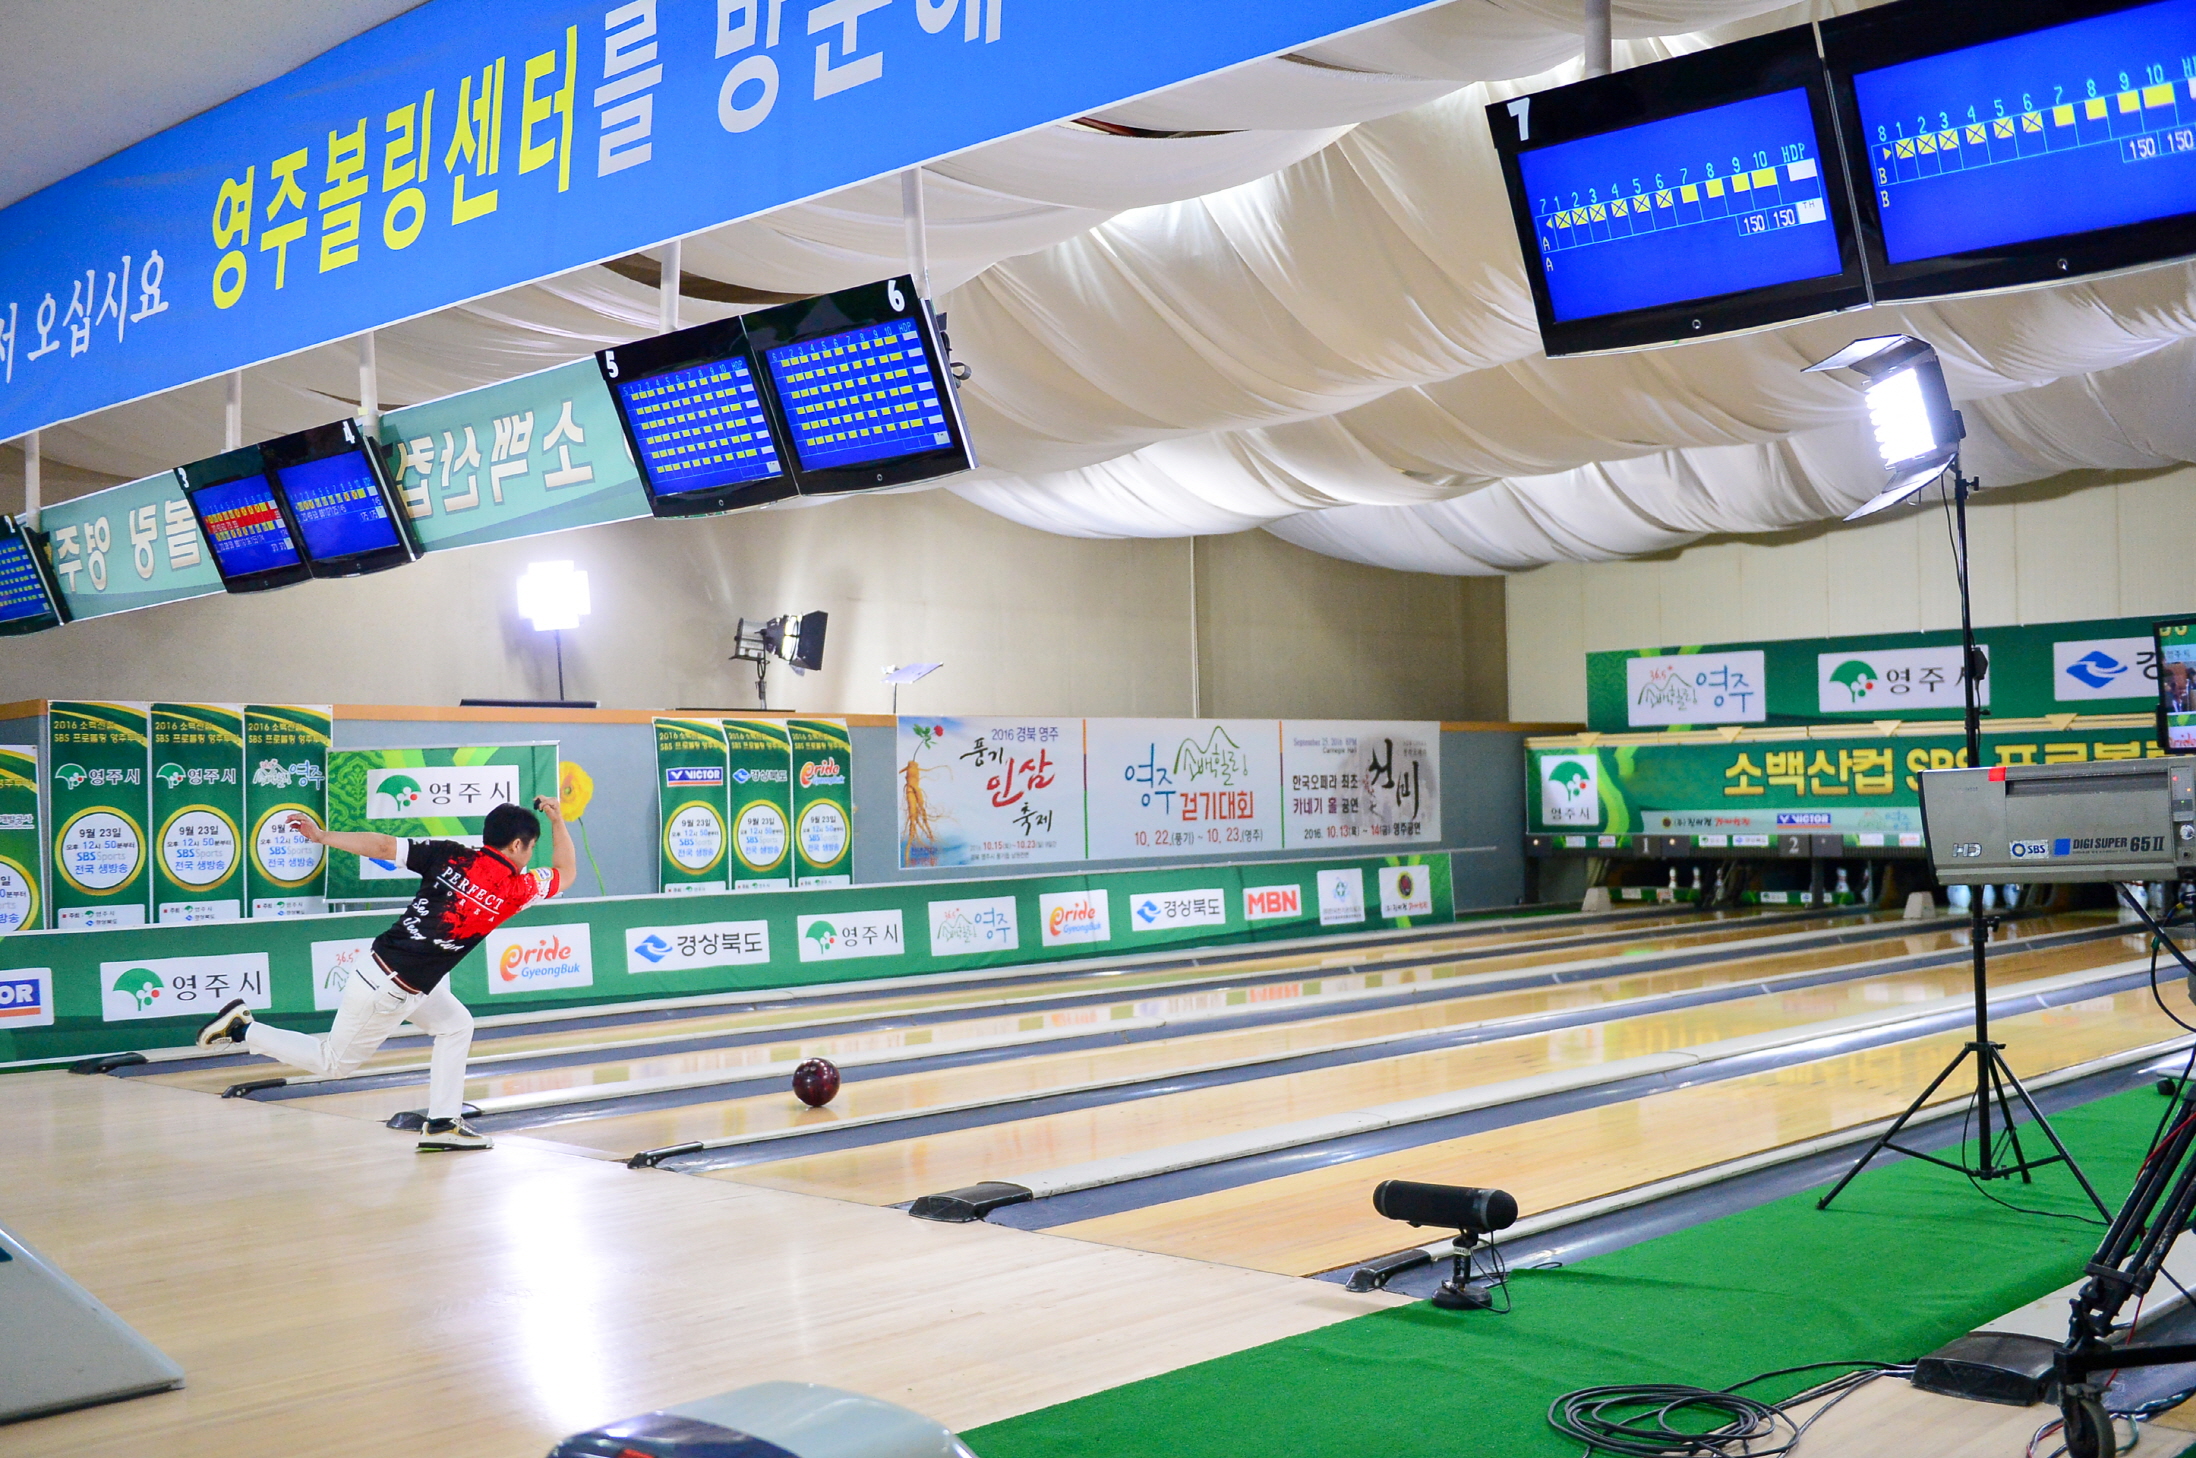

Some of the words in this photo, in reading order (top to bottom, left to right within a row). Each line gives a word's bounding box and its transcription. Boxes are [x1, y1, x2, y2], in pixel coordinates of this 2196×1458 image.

[1878, 126, 1887, 142] 8
[1895, 121, 1903, 138] 1
[1917, 116, 1928, 134] 2
[1939, 112, 1950, 129] 3
[1966, 105, 1977, 123] 4
[1994, 99, 2004, 117] 5
[2022, 93, 2032, 111] 6
[2053, 86, 2064, 104] 7
[2086, 79, 2097, 97] 8
[2119, 72, 2130, 91] 9
[2146, 64, 2164, 84] 10
[1506, 97, 1530, 141] 7
[211, 0, 664, 310] 영주볼링센터를
[1878, 167, 1887, 184] B
[2129, 137, 2156, 159] 150
[2167, 130, 2195, 153] 150
[1553, 195, 1561, 210] 1
[1571, 191, 1581, 208] 2
[1589, 187, 1598, 203] 3
[1611, 183, 1620, 199] 4
[1633, 178, 1642, 193] 5
[1655, 173, 1664, 189] 6
[1680, 168, 1689, 184] 7
[1705, 162, 1715, 178] 8
[1731, 156, 1741, 173] 9
[1752, 150, 1768, 168] 10
[1781, 142, 1806, 164] HDP
[1881, 191, 1890, 208] B
[1542, 236, 1550, 251] A
[1743, 214, 1766, 234] 150
[1772, 208, 1796, 228] 150
[1545, 258, 1554, 272] A
[887, 280, 906, 312] 6
[27, 249, 169, 361] 오십시요
[789, 349, 795, 358] 2
[798, 347, 804, 356] 3
[809, 343, 816, 352] 4
[821, 340, 827, 350] 5
[833, 338, 839, 348] 6
[845, 335, 851, 344] 7
[859, 333, 866, 342] 8
[873, 329, 879, 338] 9
[884, 326, 893, 336] 10
[898, 321, 912, 332] HDP
[605, 350, 619, 379] 5
[342, 421, 356, 444] 4
[178, 467, 190, 488] 3
[1695, 664, 1754, 713] 영주
[54, 721, 77, 730] 2016
[155, 722, 177, 730] 2016
[248, 722, 270, 731] 2016
[54, 733, 70, 743] SBS
[155, 734, 170, 743] SBS
[248, 735, 262, 743] SBS
[991, 728, 1014, 741] 2016
[1016, 726, 1037, 743] 경북
[1039, 726, 1059, 742] 영주
[959, 737, 1004, 767] 풍기
[89, 768, 141, 786] 영주시
[187, 768, 237, 785] 영주시
[289, 759, 326, 790] 영주
[685, 769, 720, 780] VICTOR
[752, 769, 788, 782] 경상북도
[986, 748, 1056, 808] 인삼
[1124, 742, 1176, 815] 영주
[1723, 747, 1894, 796] 소백산컵
[1292, 774, 1337, 790] 한국오페라
[429, 781, 511, 804] 영주시
[1180, 790, 1254, 821] 걷기대회
[1293, 797, 1323, 815] 카네기
[1341, 797, 1359, 814] 공연
[1550, 806, 1591, 821] 영주시
[681, 819, 694, 827] 9월
[696, 819, 711, 827] 23일
[761, 817, 775, 825] 23일
[822, 815, 837, 823] 23일
[1012, 802, 1053, 836] 축제
[1790, 813, 1830, 824] VICTOR
[79, 829, 96, 839] 9월
[99, 828, 121, 838] 23일
[179, 826, 194, 836] 9월
[198, 826, 219, 836] 23일
[271, 824, 286, 833] 9월
[1393, 822, 1421, 835] 영주공연
[83, 841, 101, 849] 12시
[104, 840, 135, 849] 50분부터
[182, 839, 200, 847] 12시
[274, 836, 290, 844] 12시
[679, 838, 694, 846] SBS
[746, 836, 758, 844] SBS
[808, 834, 821, 842] SBS
[1641, 837, 1649, 854] 1
[1788, 836, 1800, 854] 2
[2072, 838, 2094, 849] DIGI
[2094, 837, 2128, 848] SUPER
[2130, 837, 2150, 852] 65
[76, 852, 96, 861] SBS
[176, 849, 195, 858] SBS
[269, 846, 287, 855] SBS
[1952, 842, 1982, 857] HD
[2027, 845, 2046, 854] SBS
[75, 864, 94, 875] 전국
[98, 863, 128, 874] 생방송
[175, 861, 194, 871] 전국
[197, 860, 225, 870] 생방송
[268, 858, 285, 868] 전국
[288, 857, 315, 867] 생방송
[441, 866, 504, 911] PERFECT
[1164, 898, 1220, 918] 경상북도
[1247, 890, 1297, 914] MBN
[974, 907, 1011, 943] 영주
[842, 922, 899, 947] 영주시
[677, 931, 763, 956] 경상북도
[521, 963, 580, 979] GyeongBuk
[172, 970, 262, 1001] 영주시
